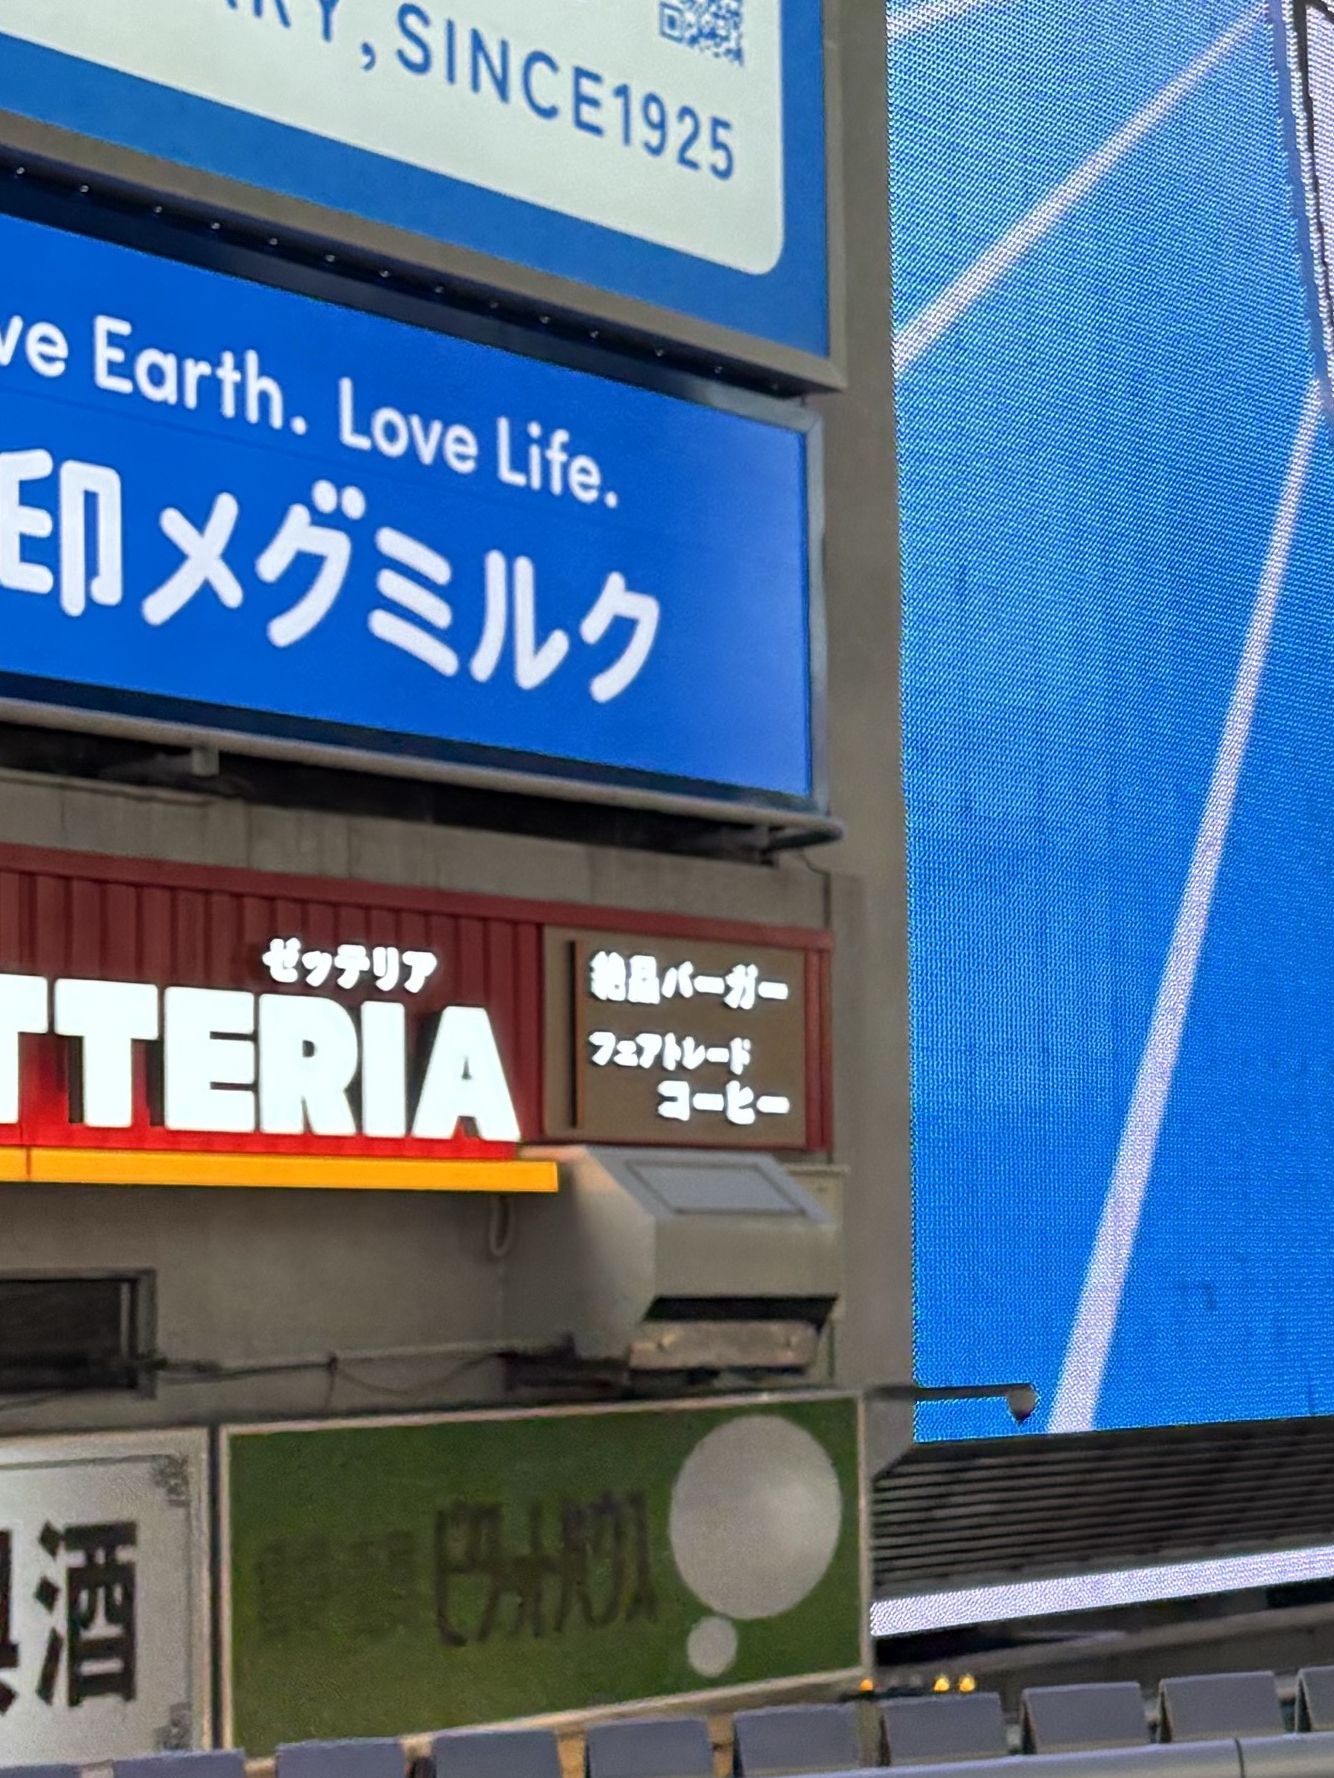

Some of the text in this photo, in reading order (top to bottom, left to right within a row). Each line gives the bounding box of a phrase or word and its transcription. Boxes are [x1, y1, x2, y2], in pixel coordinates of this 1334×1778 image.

[93, 313, 308, 436] Earth.
[338, 376, 478, 473] Love
[497, 415, 619, 509] Life.
[262, 936, 439, 995] ゼッテリア
[588, 1031, 752, 1076] フェアトレード
[656, 1079, 790, 1126] コーヒー
